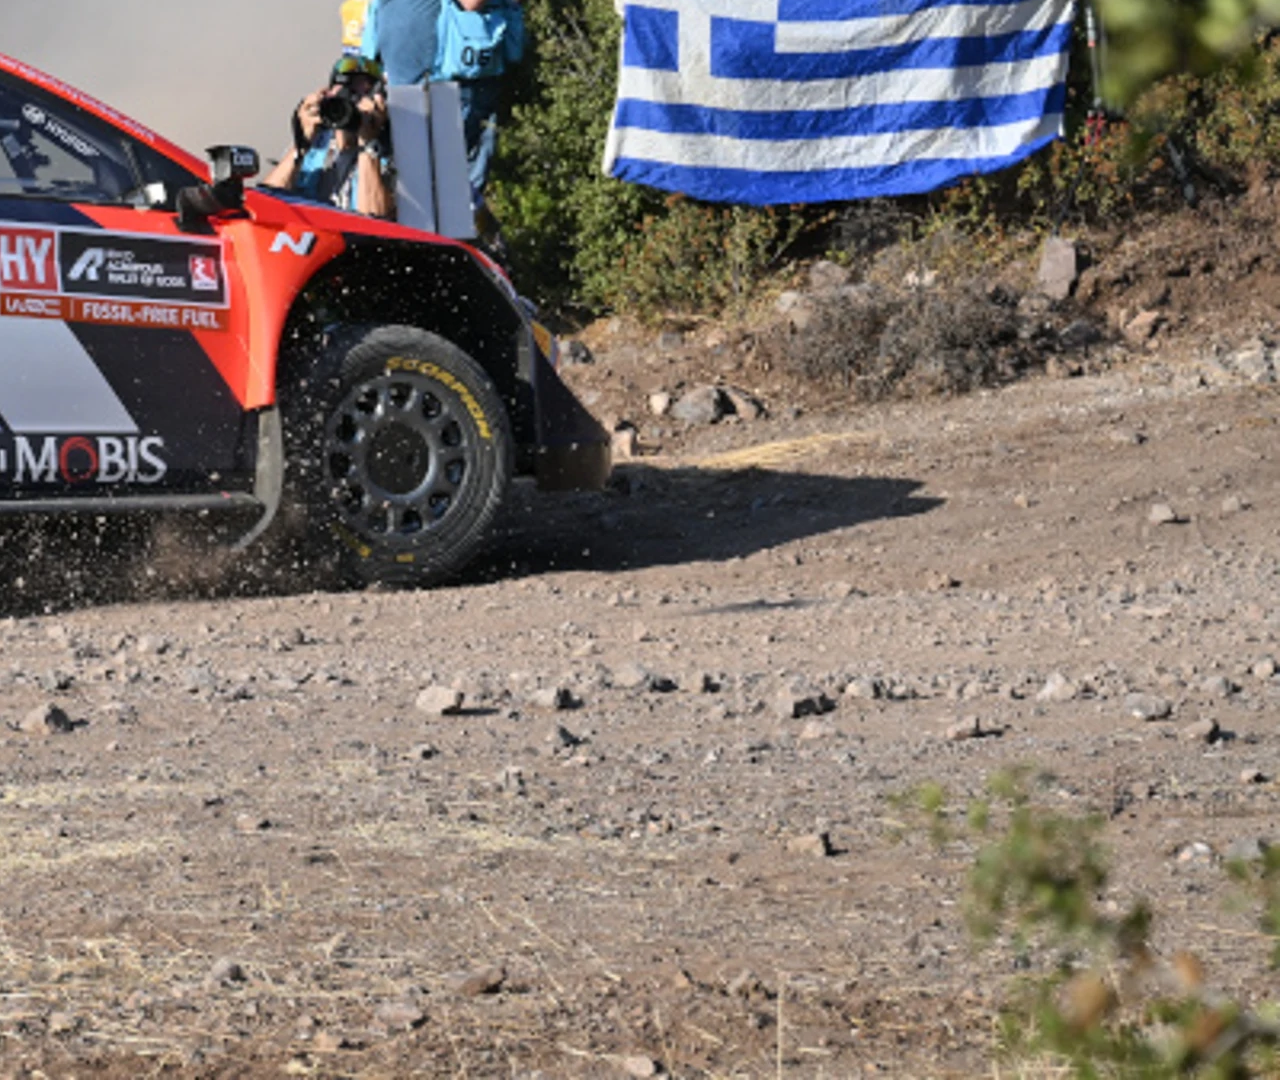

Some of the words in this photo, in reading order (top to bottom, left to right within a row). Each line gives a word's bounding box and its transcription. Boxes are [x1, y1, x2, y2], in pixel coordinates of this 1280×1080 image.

[0, 235, 52, 283] HY
[182, 310, 220, 328] FUEL
[386, 357, 492, 438] SCORPION
[13, 436, 168, 483] MOBIS
